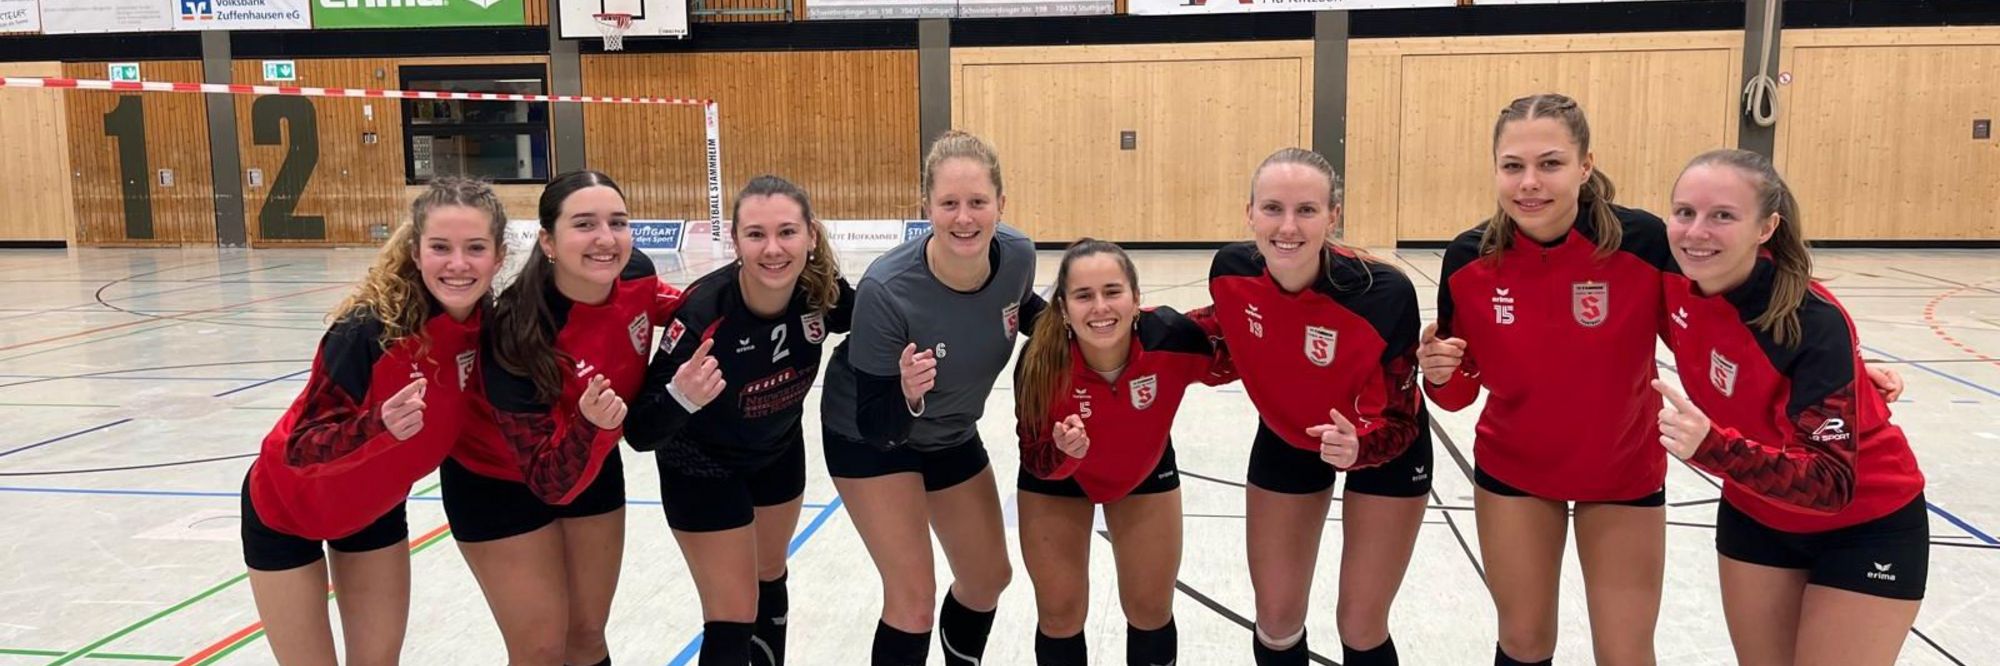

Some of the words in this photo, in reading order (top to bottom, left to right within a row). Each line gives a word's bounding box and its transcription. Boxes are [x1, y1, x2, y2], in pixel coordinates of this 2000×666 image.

[217, 10, 284, 20] Zuffenhausen
[286, 10, 300, 19] eG
[104, 95, 154, 240] 1
[252, 94, 326, 240] 2
[1493, 304, 1515, 325] 15
[1247, 317, 1264, 339] 19
[770, 323, 790, 364] 2
[935, 342, 947, 359] 6
[1079, 401, 1092, 419] 5
[1821, 432, 1850, 441] SPORT
[1866, 571, 1896, 581] erima
